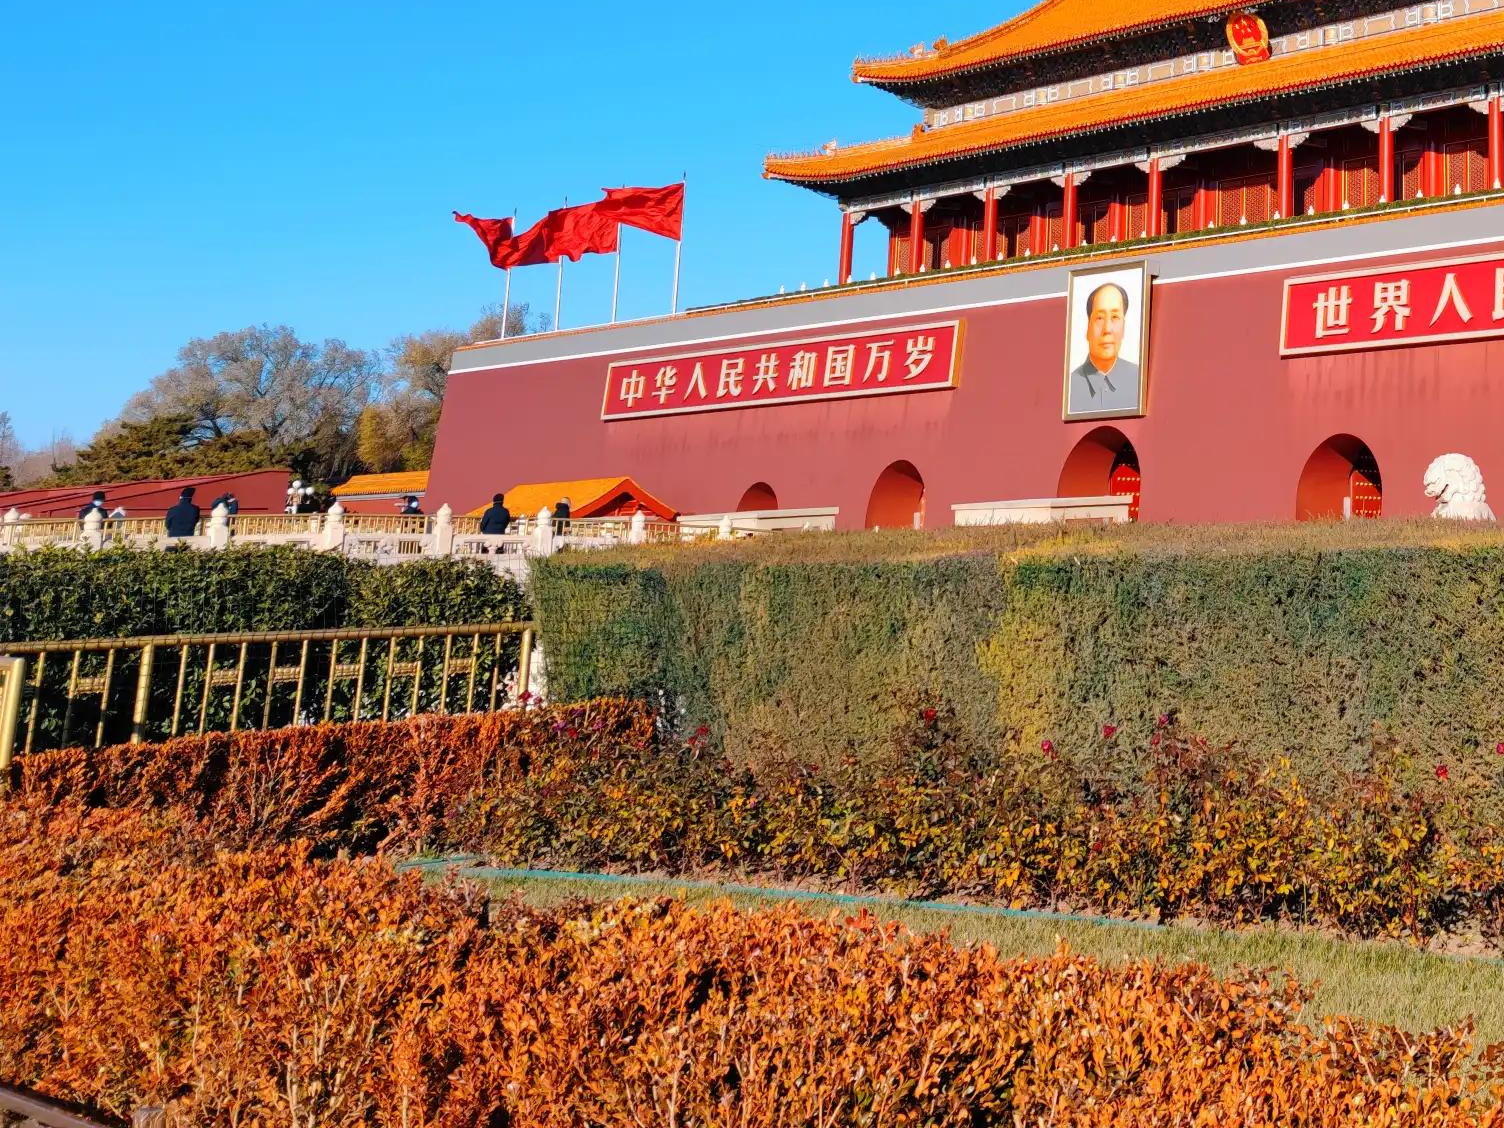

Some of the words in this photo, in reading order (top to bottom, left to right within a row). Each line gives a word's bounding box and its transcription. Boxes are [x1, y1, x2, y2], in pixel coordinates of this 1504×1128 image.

[619, 335, 936, 408] 中华人民共和国万岁
